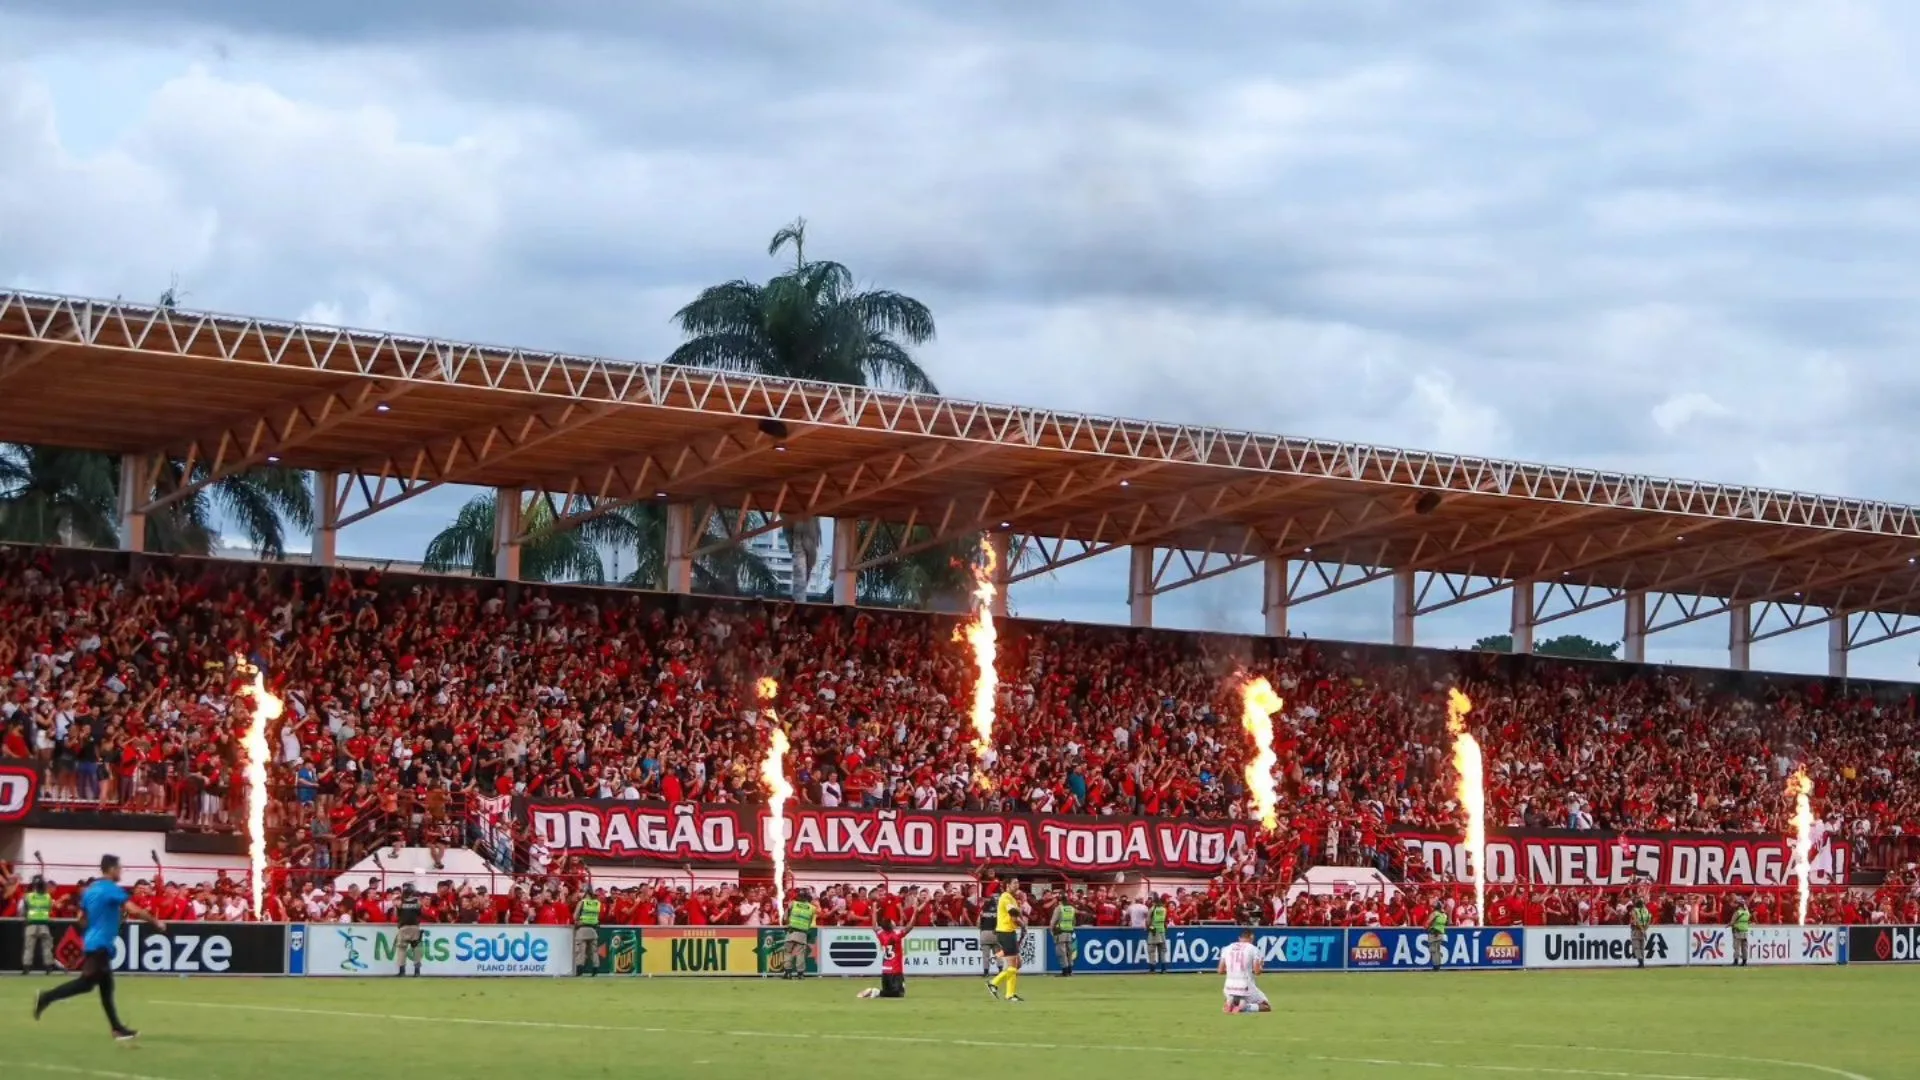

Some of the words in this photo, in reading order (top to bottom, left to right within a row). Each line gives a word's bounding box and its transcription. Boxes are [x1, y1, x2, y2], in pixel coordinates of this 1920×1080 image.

[534, 804, 750, 857] DRAGÃO,
[763, 810, 933, 857] PAIXÃO
[946, 821, 1034, 859] PRA
[1044, 826, 1150, 864] TODA
[1527, 844, 1660, 885] NELES
[455, 932, 548, 962] Saúde
[672, 938, 729, 971] KUAT
[1749, 939, 1790, 959] ristal
[1892, 927, 1920, 960] bl
[477, 963, 504, 972] PLANO
[507, 963, 517, 972] DE
[904, 957, 929, 966] AMA
[938, 956, 997, 966] SINTETC
